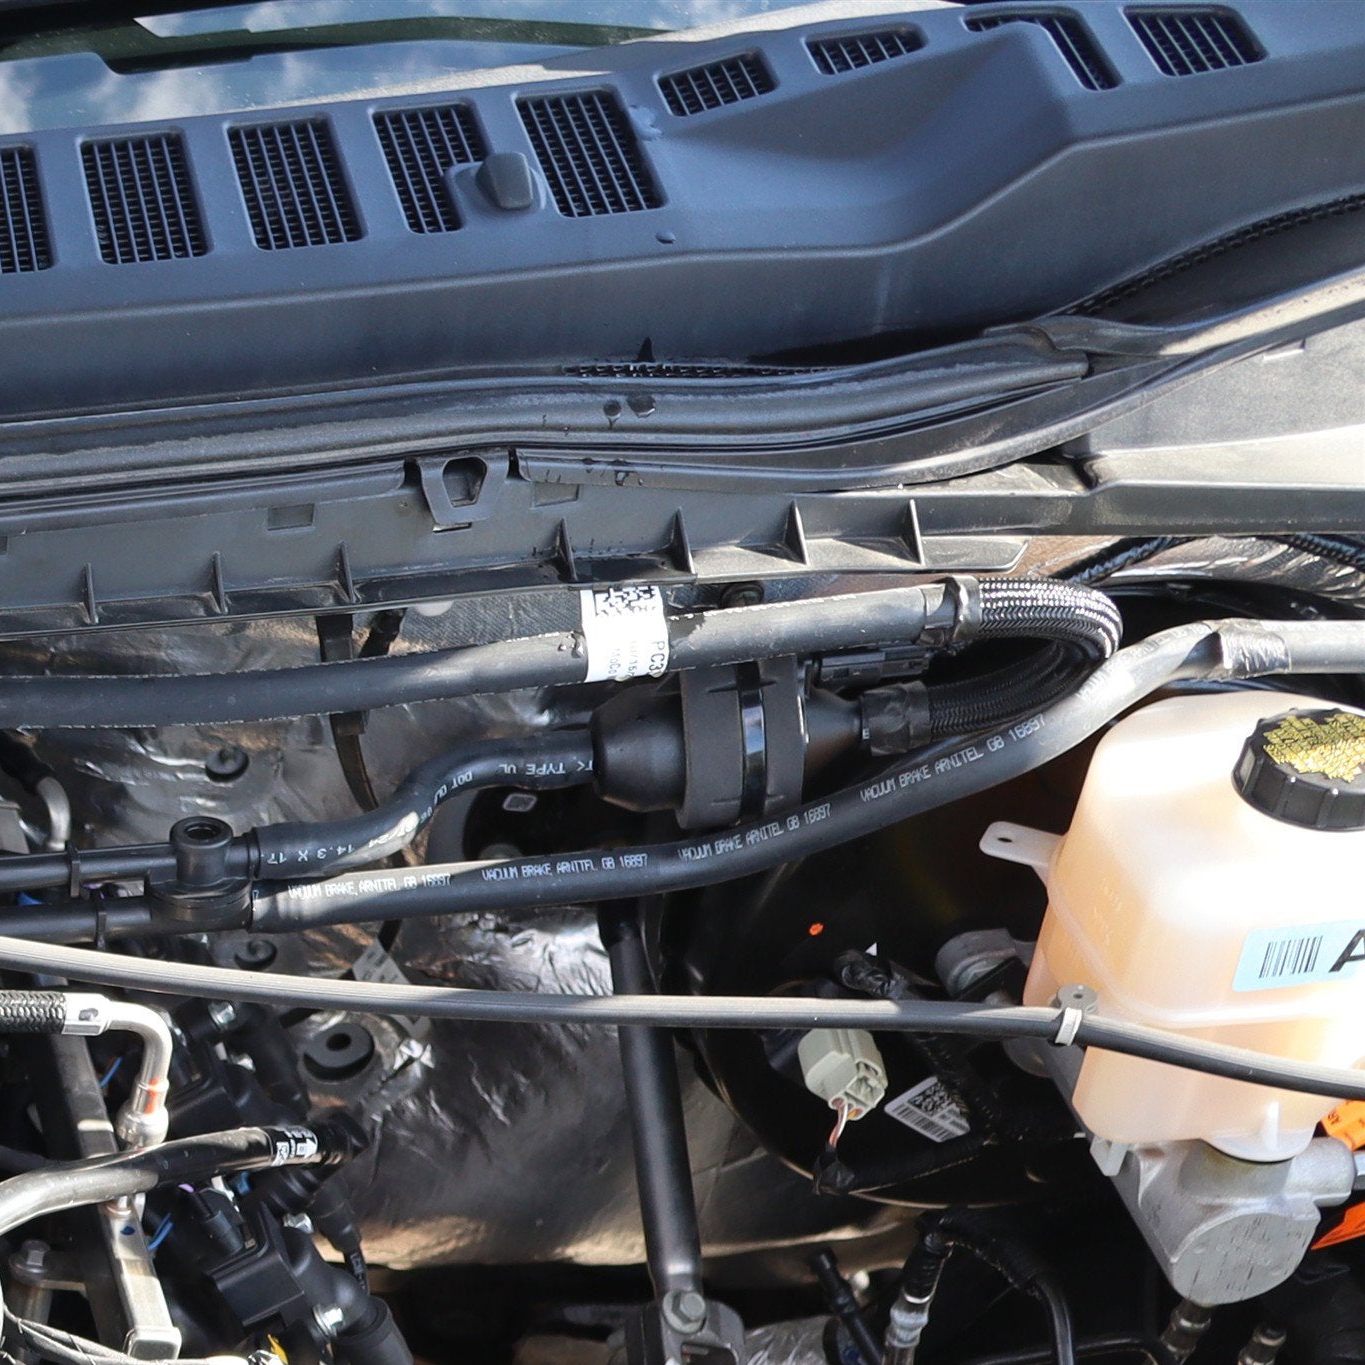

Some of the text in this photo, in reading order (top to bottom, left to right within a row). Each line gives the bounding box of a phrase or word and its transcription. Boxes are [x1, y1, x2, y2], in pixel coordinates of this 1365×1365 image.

[860, 713, 1046, 802] VACUUM BRAKE ARNITEL GB 16897
[525, 762, 565, 776] TYPE
[452, 771, 473, 789] DOT
[677, 845, 712, 861] VACUUM
[714, 834, 743, 854] BRAKE
[746, 822, 784, 846] ARNITEL
[787, 815, 800, 831] GB
[481, 866, 518, 881] VACUUM
[522, 862, 552, 878] BRAKE
[602, 856, 615, 870] GB
[325, 880, 357, 897] BRAKE
